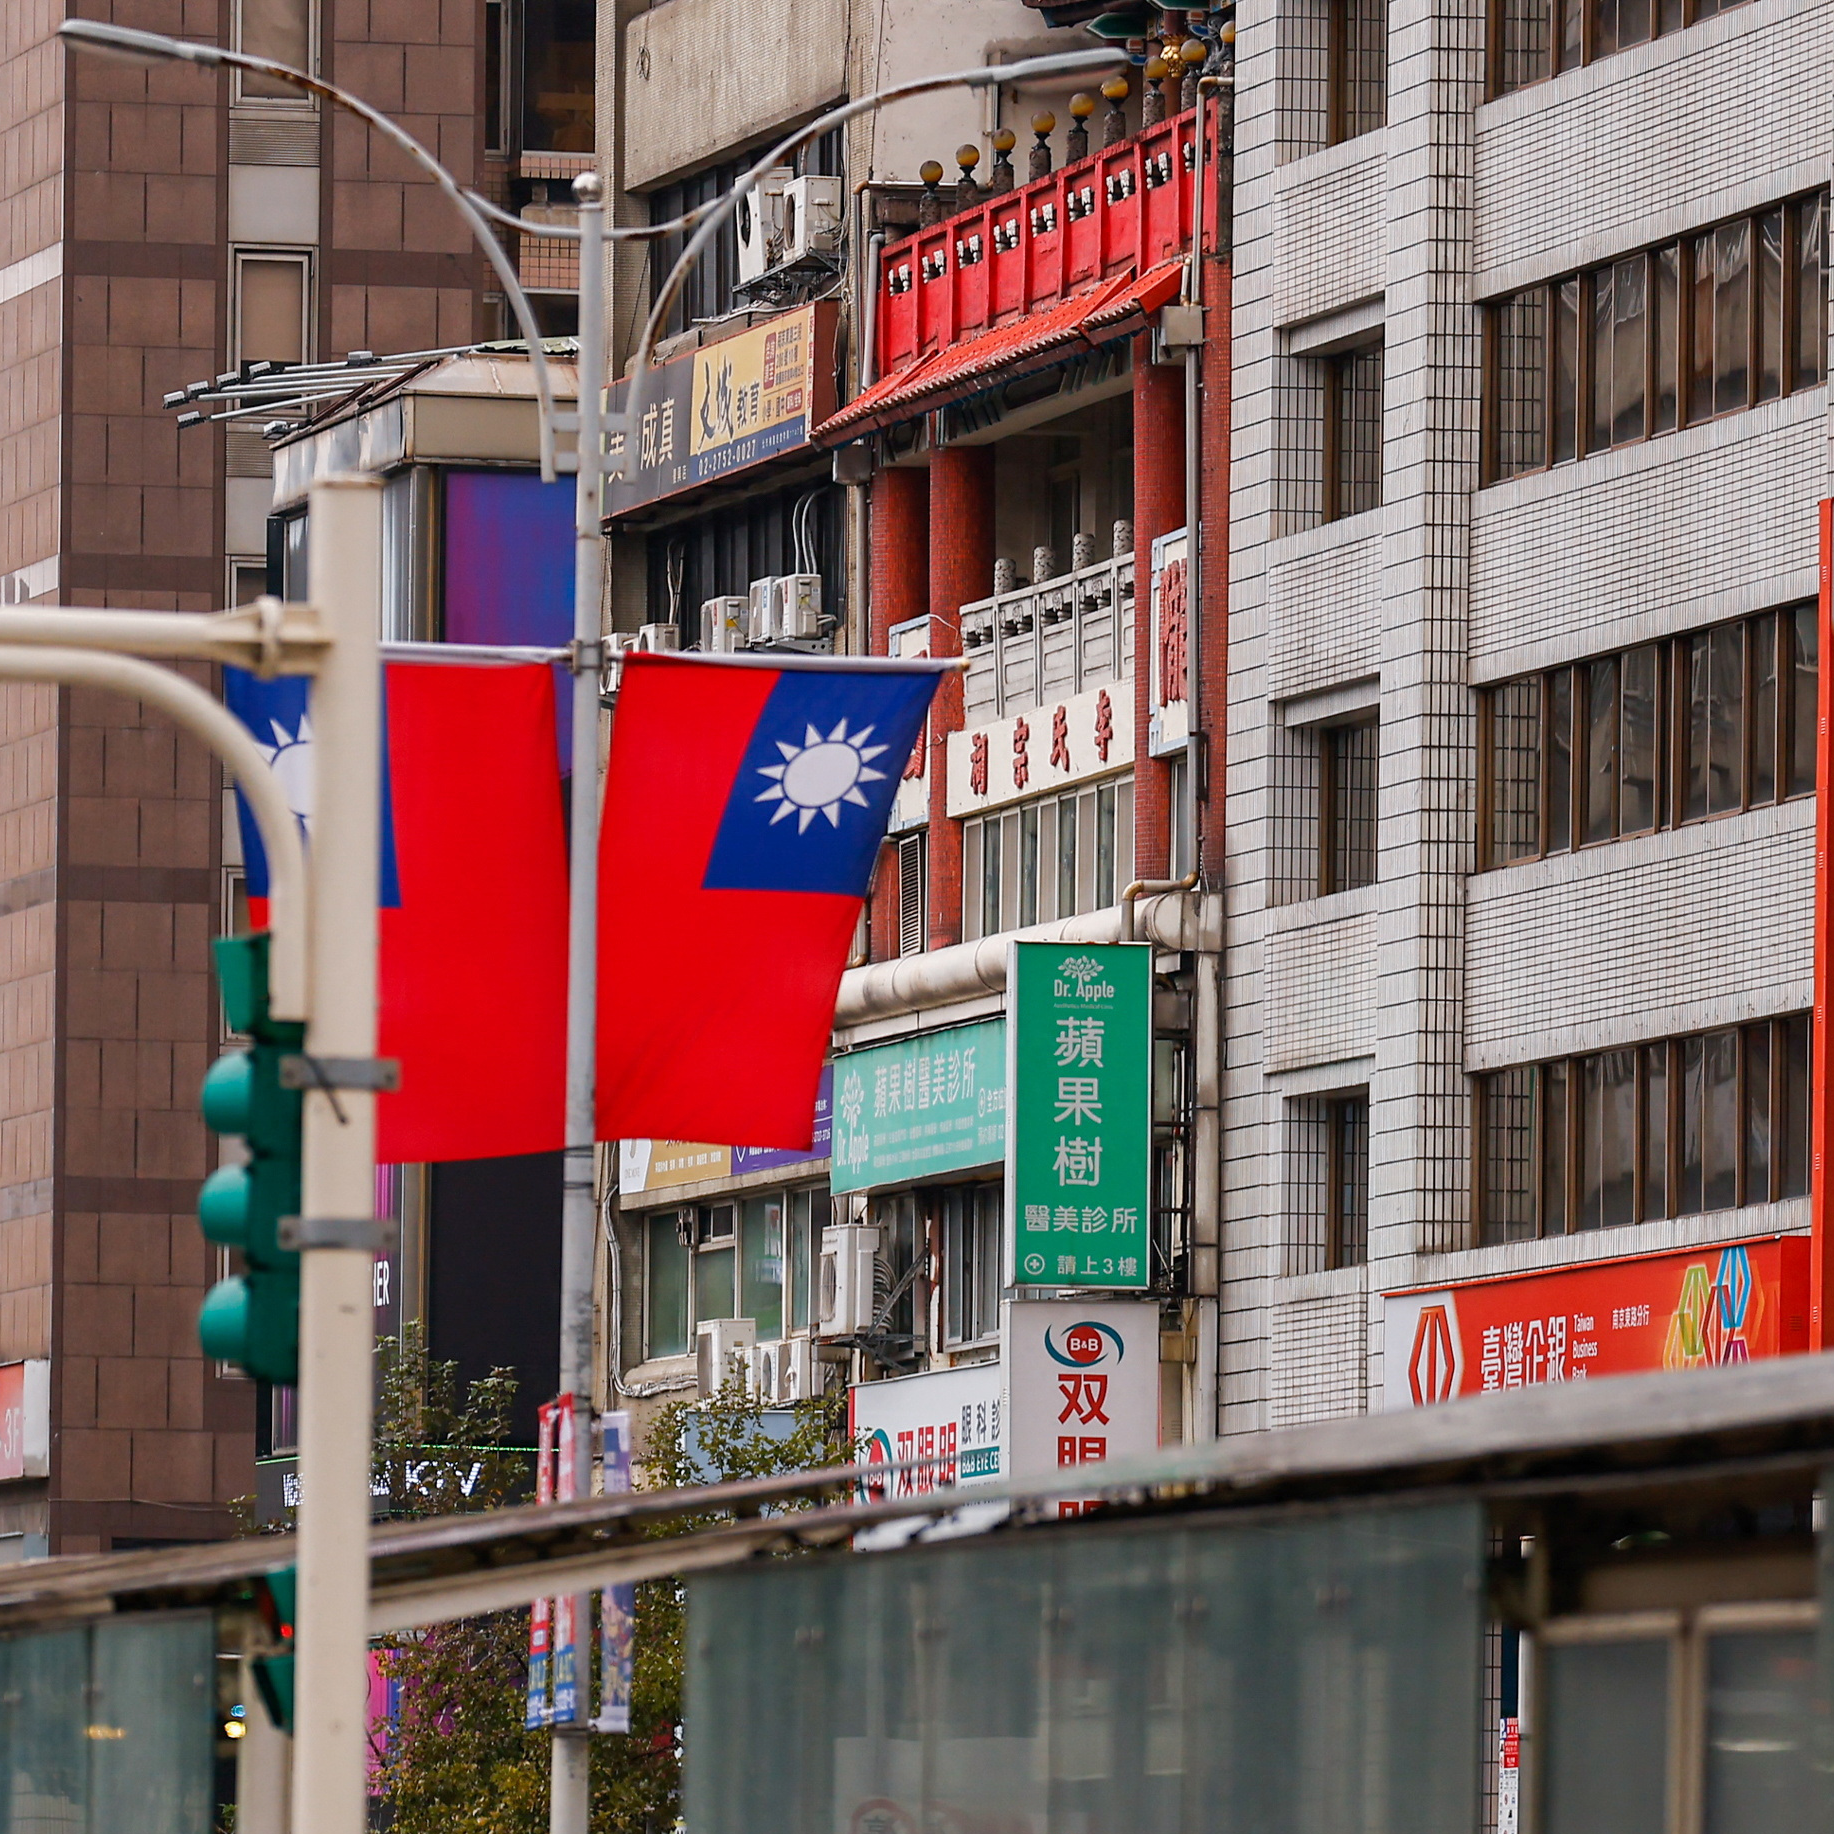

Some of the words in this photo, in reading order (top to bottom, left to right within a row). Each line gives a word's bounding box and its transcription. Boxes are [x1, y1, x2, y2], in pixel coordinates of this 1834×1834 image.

[698, 438, 757, 477] 02-2752-0027
[1053, 978, 1072, 998] Dr.
[1075, 980, 1115, 1002] Apple
[1052, 1016, 1105, 1187] 蘋果樹
[1024, 1204, 1138, 1234] 醫美診所
[1057, 1255, 1138, 1277] 請上3樓
[373, 1260, 390, 1307] ER
[1573, 1313, 1594, 1333] Taiwan
[1612, 1304, 1650, 1331] 南京東路分行
[1070, 1337, 1099, 1351] B&B
[1480, 1315, 1567, 1395] 臺灣企銀
[1572, 1338, 1598, 1359] Business
[4, 1408, 20, 1460] 3F
